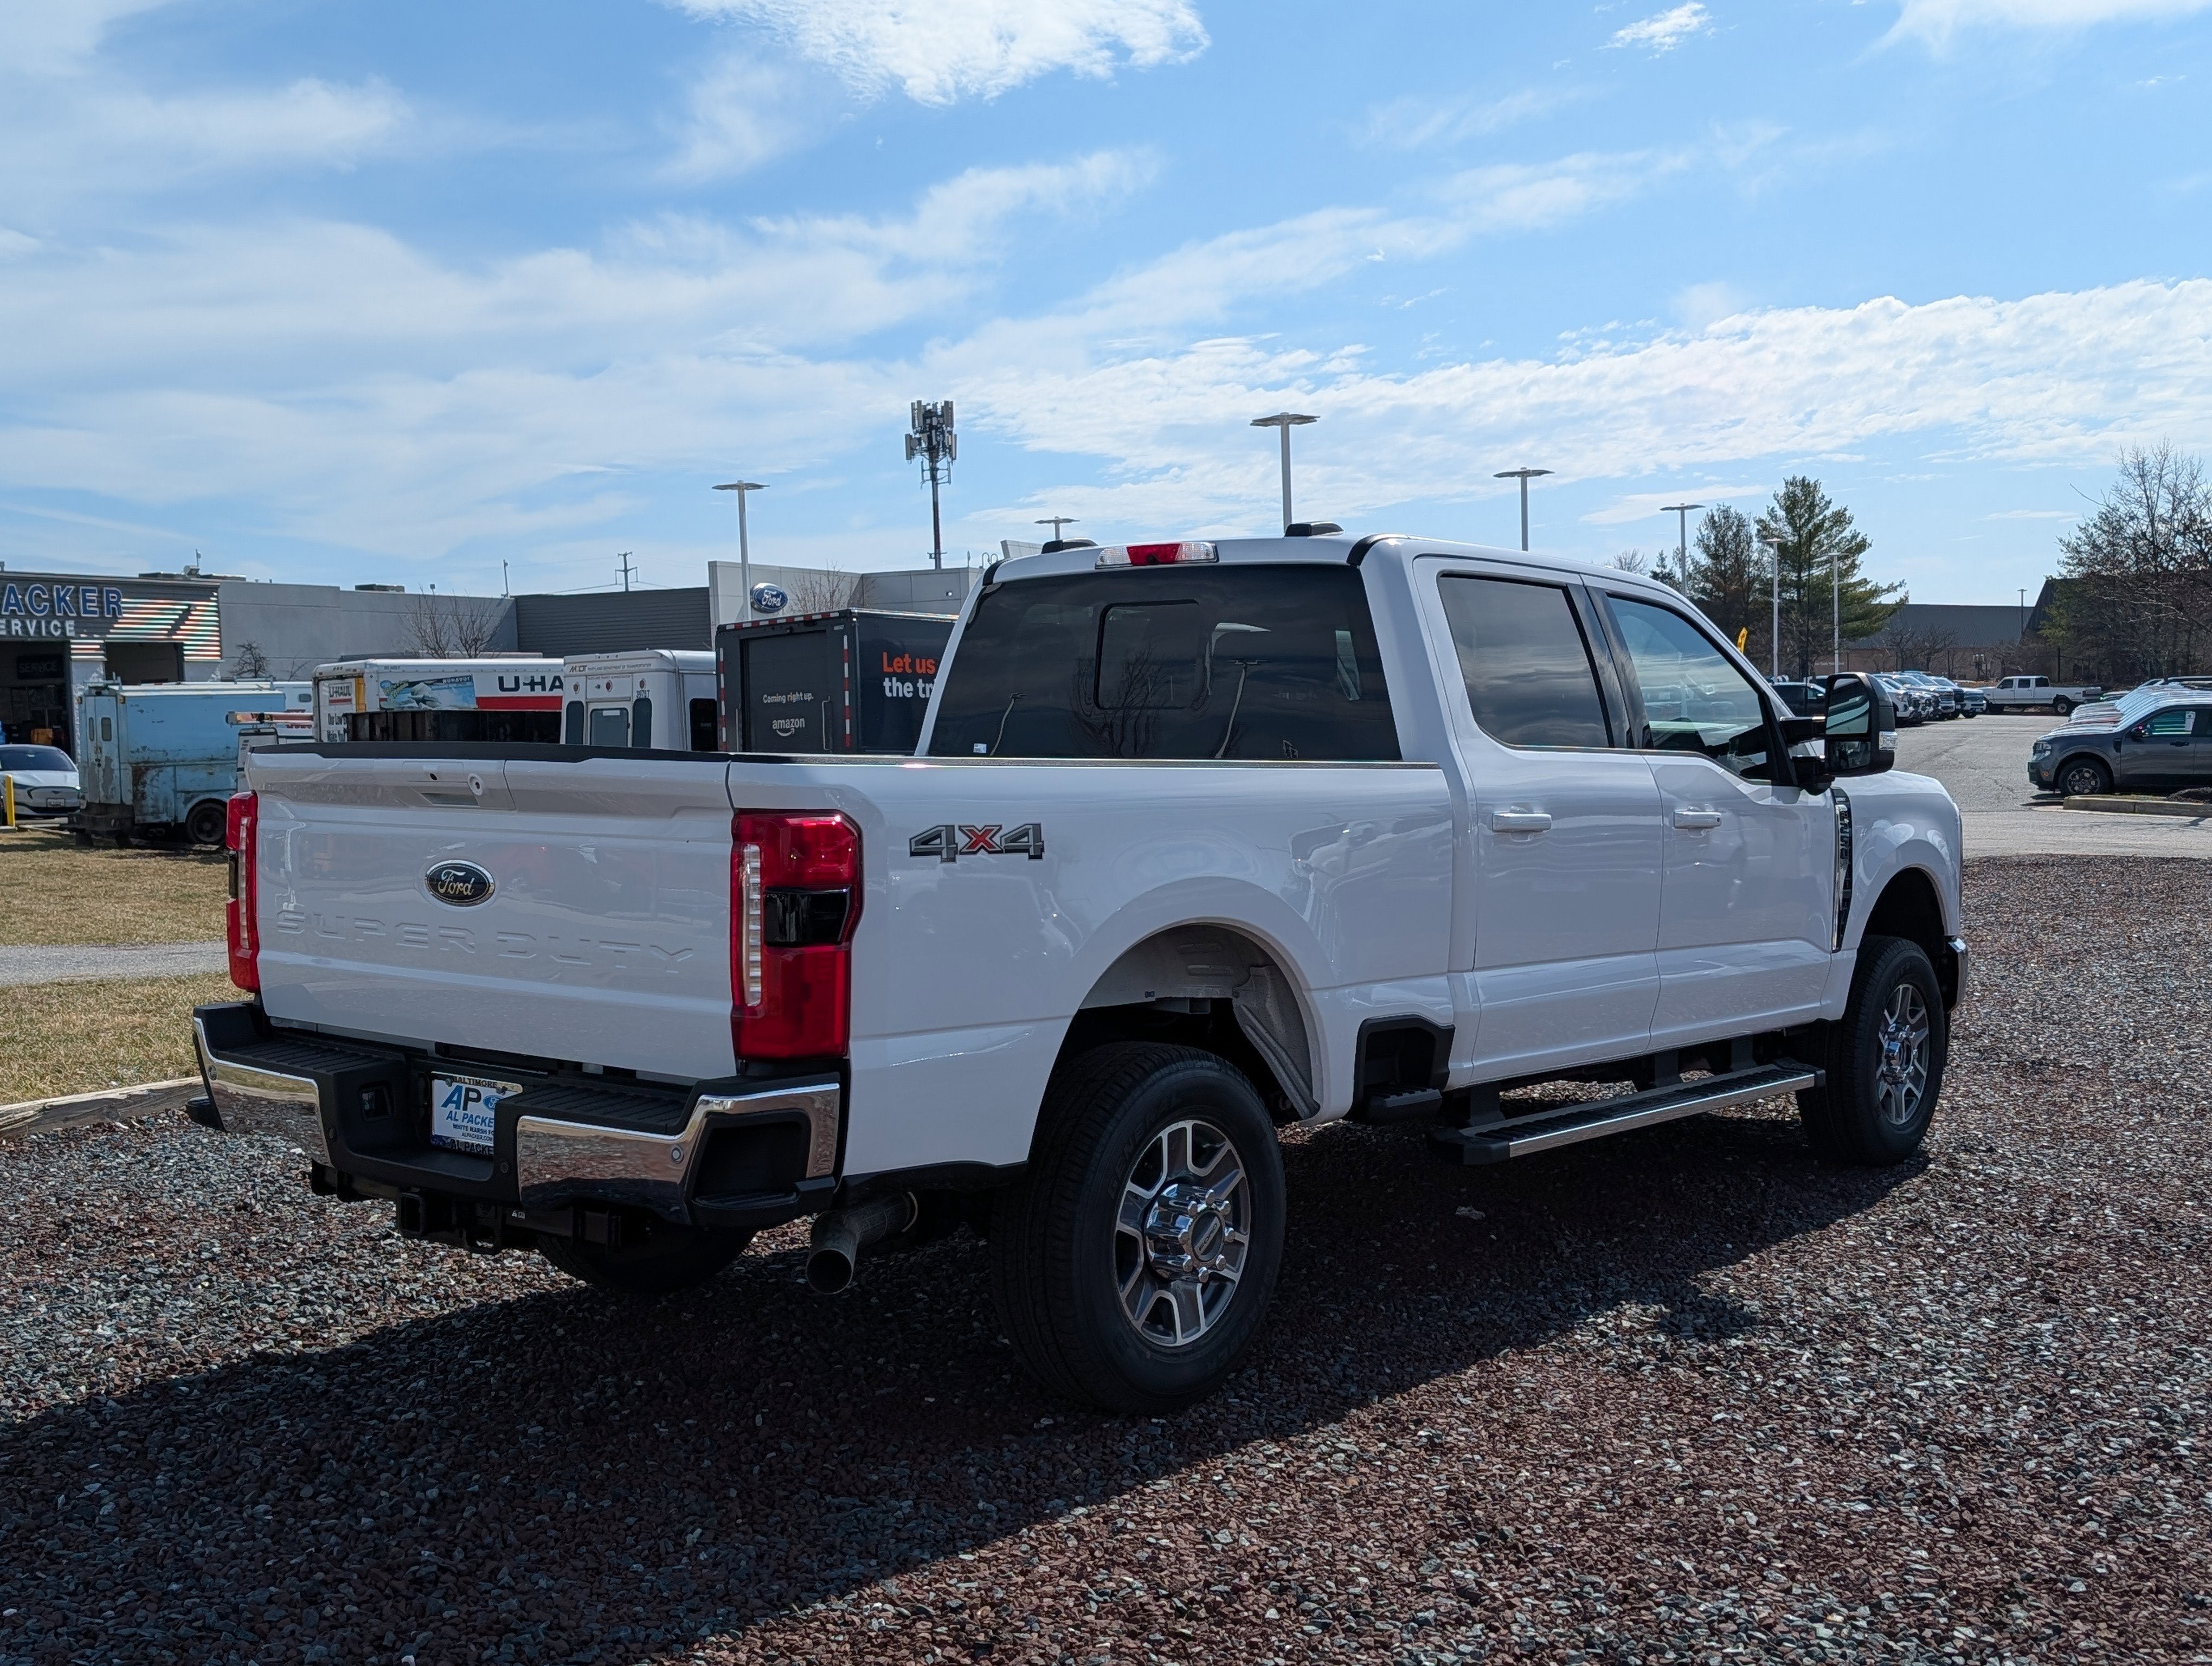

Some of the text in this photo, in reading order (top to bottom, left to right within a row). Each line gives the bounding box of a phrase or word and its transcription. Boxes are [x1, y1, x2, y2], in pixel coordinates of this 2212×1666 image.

[2, 584, 123, 618] ACKER
[761, 589, 782, 607] Ford
[883, 651, 936, 674] Let us
[763, 692, 814, 703] Coming right up.
[883, 677, 936, 698] the tr
[772, 717, 805, 729] amazon
[438, 869, 475, 896] Ford
[276, 909, 693, 974] SUPER DUTY
[441, 1085, 482, 1111] AP
[446, 1110, 459, 1122] AL
[451, 1138, 461, 1151] AL
[1199, 1223, 1218, 1252] FORD
